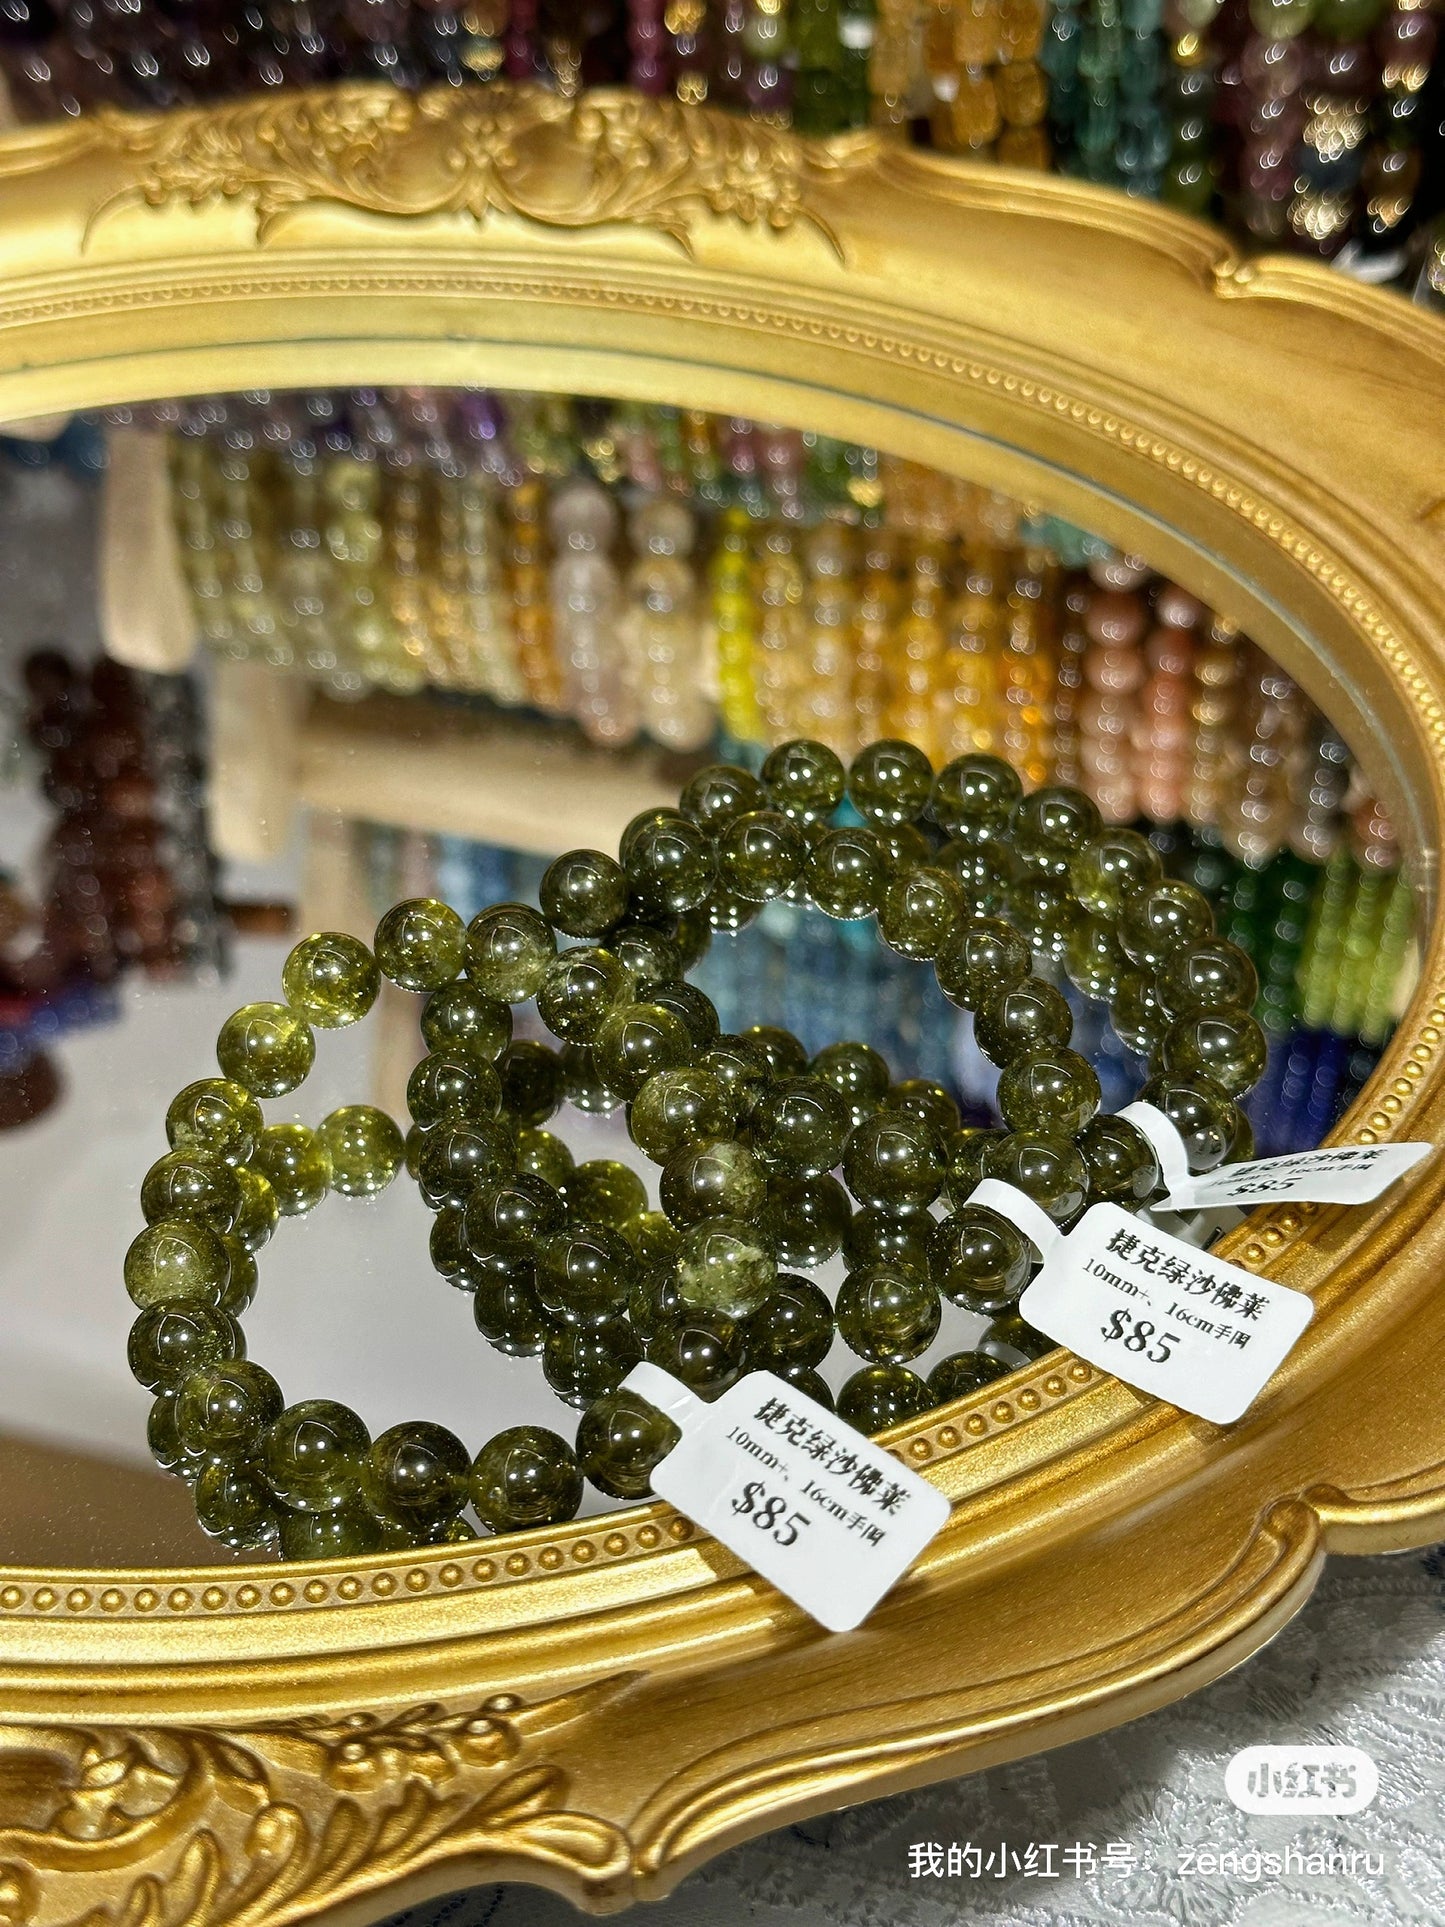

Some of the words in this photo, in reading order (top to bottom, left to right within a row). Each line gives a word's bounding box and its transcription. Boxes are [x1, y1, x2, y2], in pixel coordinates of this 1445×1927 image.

[1227, 1176, 1303, 1197] $85
[1105, 1228, 1270, 1321] 捷克绿沙佛莱
[1100, 1308, 1181, 1363] $85
[754, 1397, 911, 1515] 捷克绿沙佛莱
[732, 1480, 811, 1546] $85
